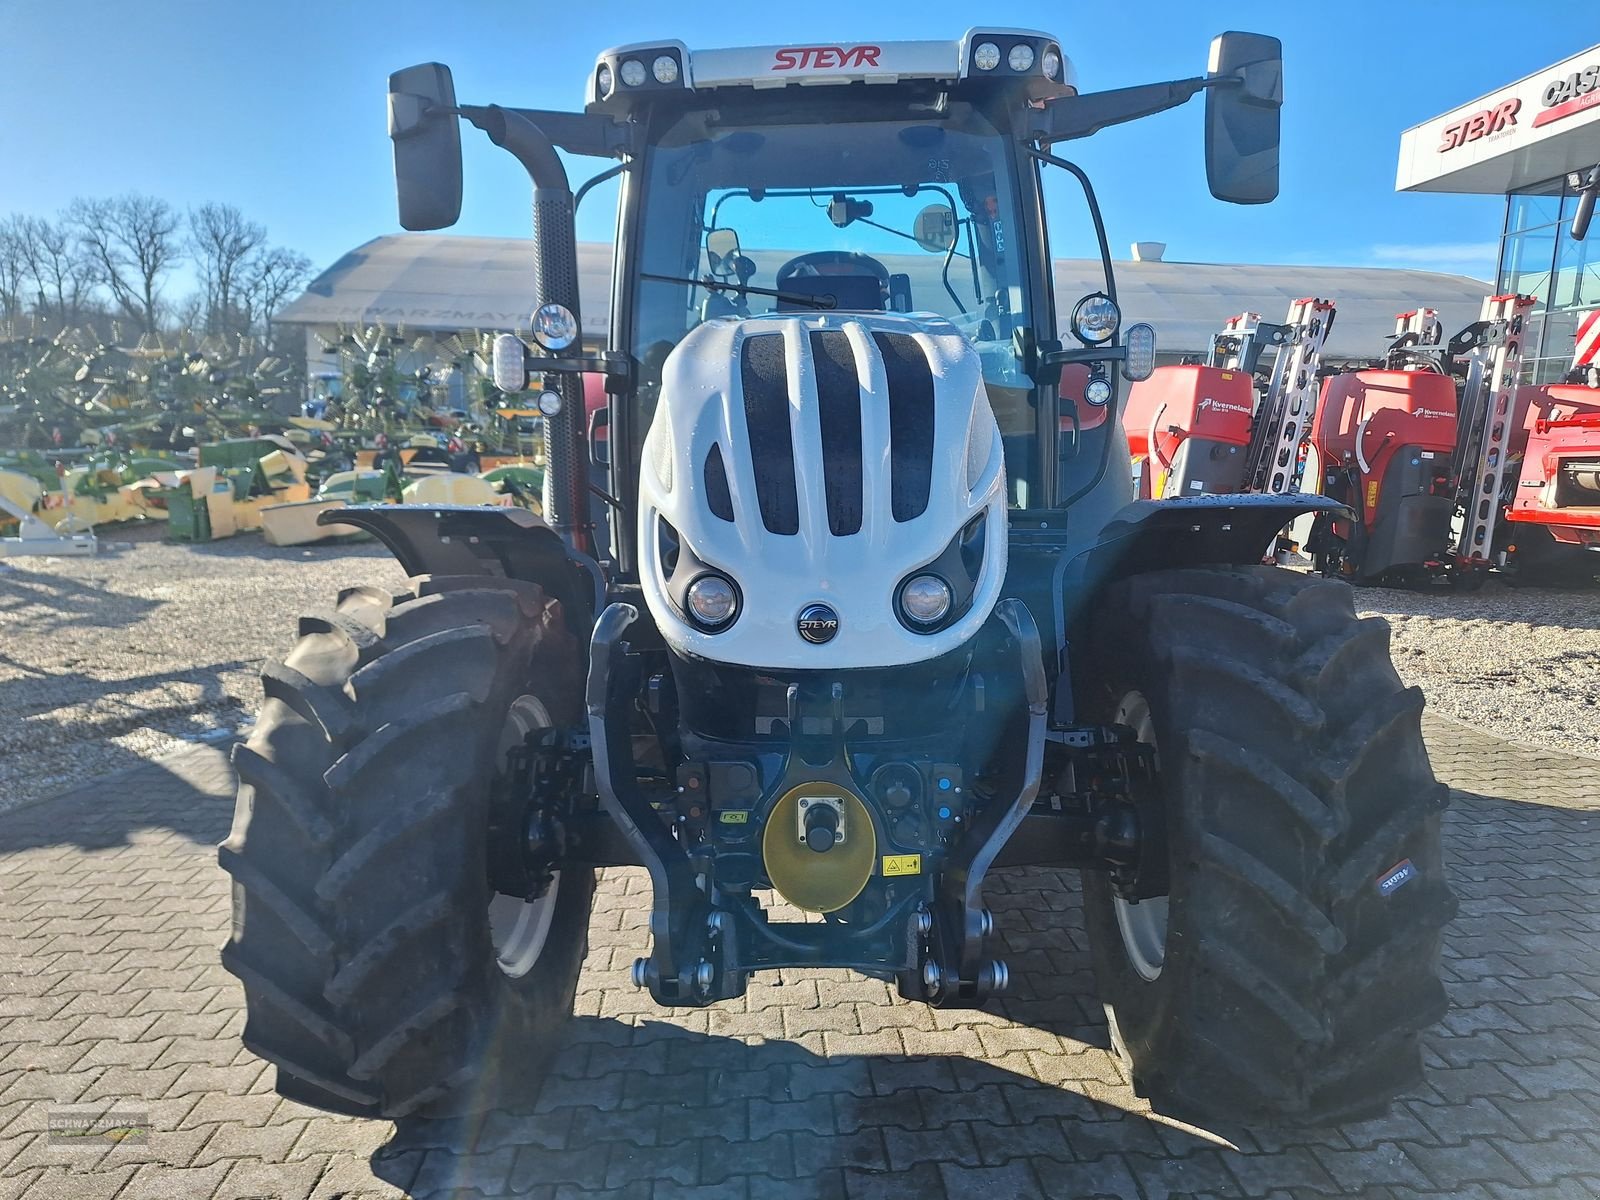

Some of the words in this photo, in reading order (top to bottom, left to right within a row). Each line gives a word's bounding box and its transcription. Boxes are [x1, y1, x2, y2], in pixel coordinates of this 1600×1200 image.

[771, 46, 881, 71] STEYR
[1541, 65, 1600, 107] CAS
[1437, 98, 1522, 153] STEYR
[1212, 400, 1252, 414] Kverneland
[1424, 408, 1456, 418] Kverneland
[799, 620, 837, 629] STEYR
